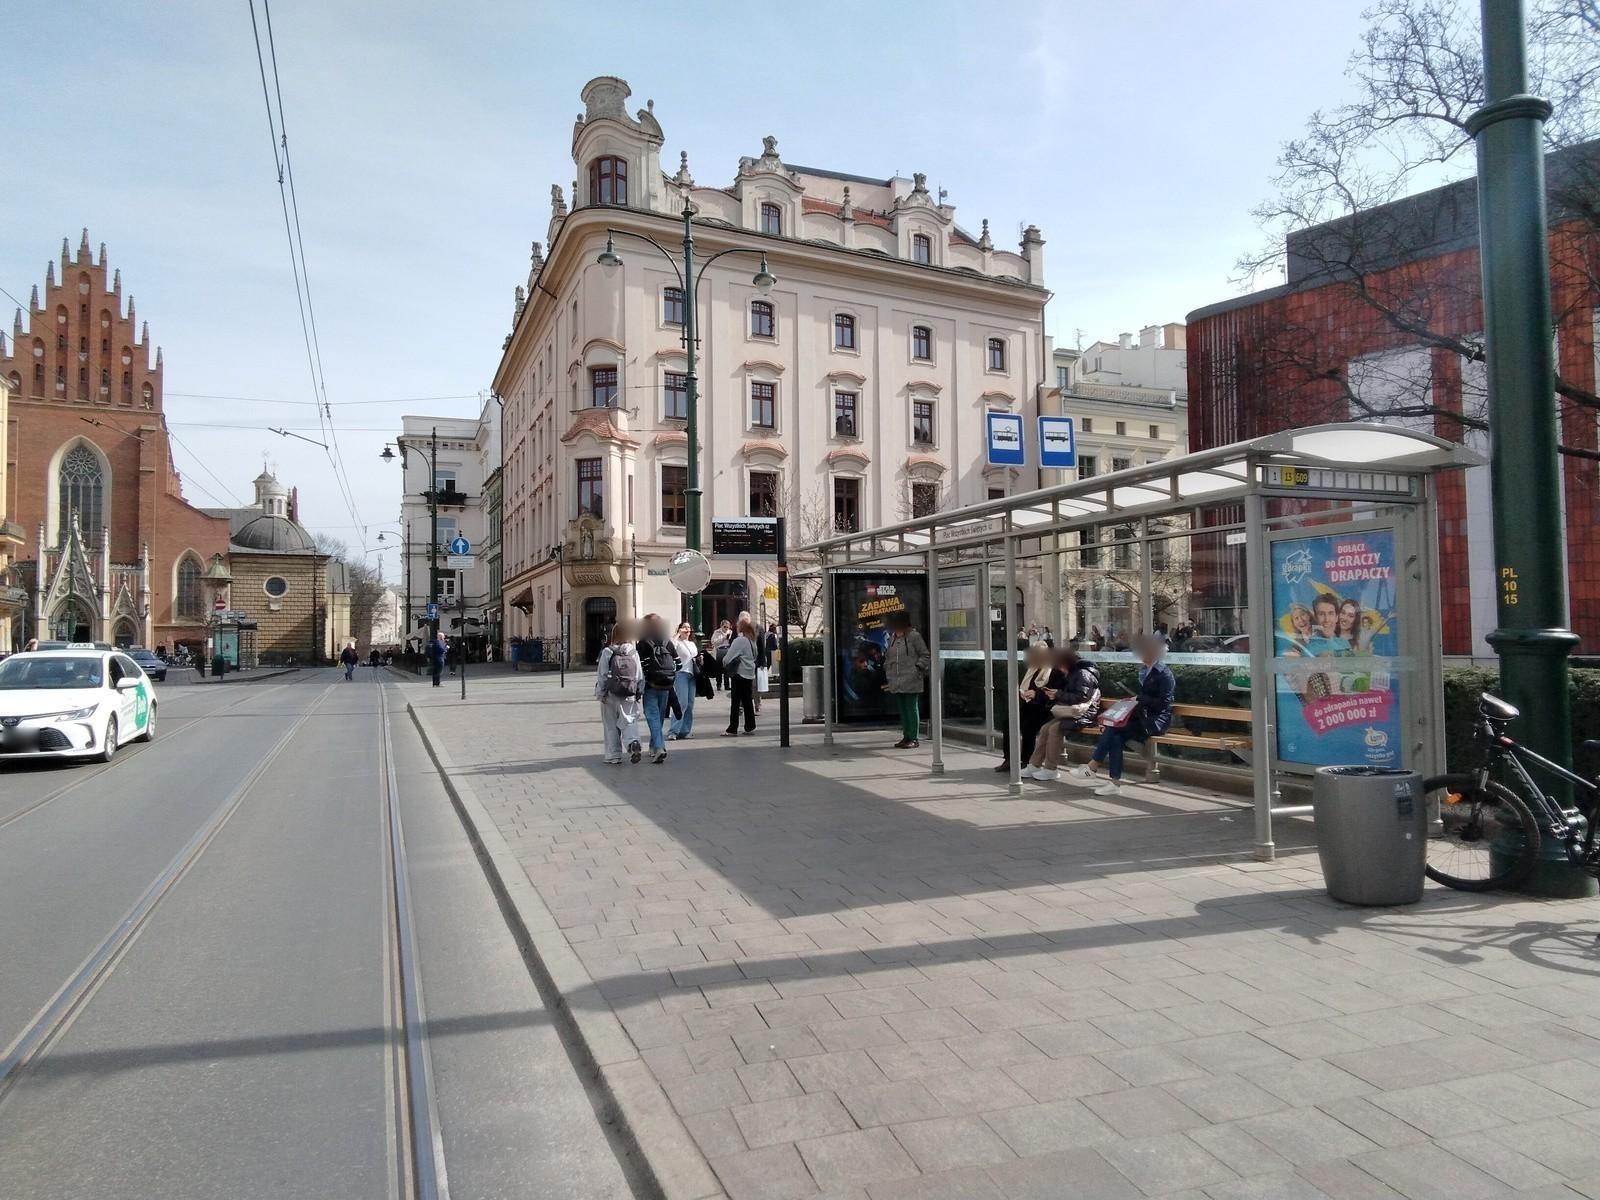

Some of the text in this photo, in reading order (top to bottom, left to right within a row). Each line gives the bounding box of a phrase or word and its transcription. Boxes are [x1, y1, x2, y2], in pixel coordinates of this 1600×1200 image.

[1295, 473, 1308, 483] 609
[1337, 543, 1366, 554] DOŁĄCZ
[1325, 552, 1381, 569] DO GRACZY
[1331, 567, 1390, 583] DRAPACZY
[1502, 567, 1518, 578] PL
[1503, 581, 1517, 591] 10
[861, 596, 900, 612] ZABAWA
[1504, 594, 1518, 604] 15
[1314, 696, 1383, 718] do zdrapania nawet
[1318, 706, 1377, 730] 2 000 000 zł
